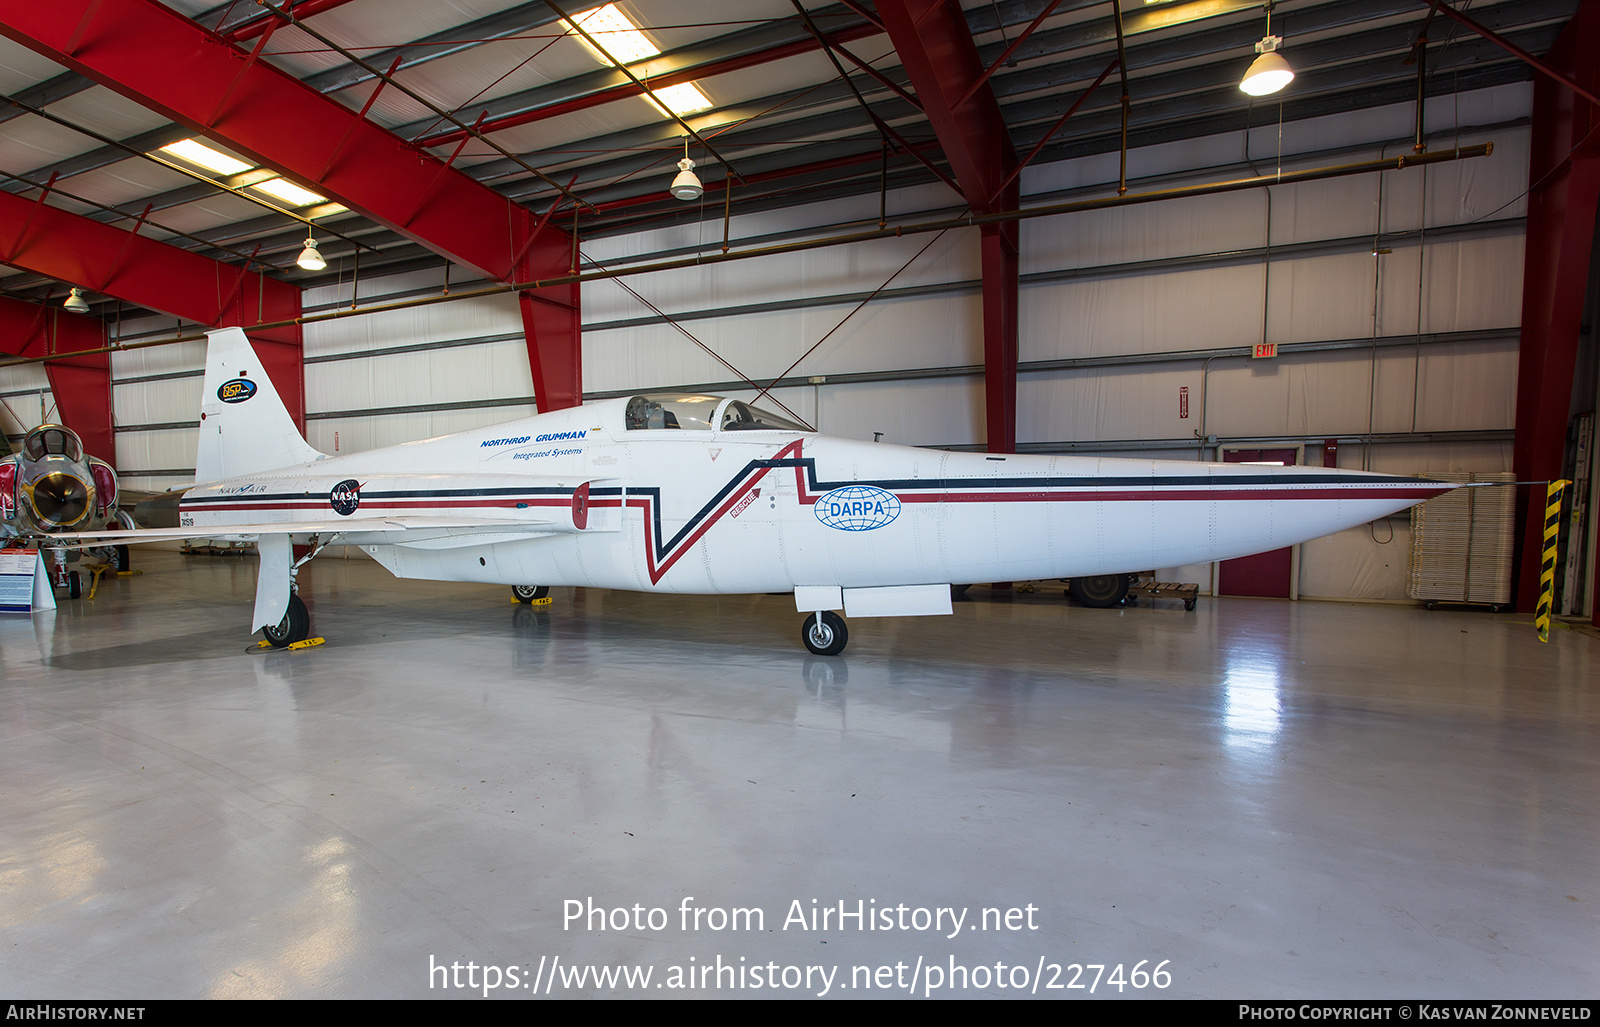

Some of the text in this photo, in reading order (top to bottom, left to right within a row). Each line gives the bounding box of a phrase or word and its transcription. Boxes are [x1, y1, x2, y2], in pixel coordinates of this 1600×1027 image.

[1256, 343, 1274, 357] EXIT
[480, 430, 587, 447] NORTHROP GRUMMAN
[512, 447, 584, 461] Integrated Systems
[332, 491, 358, 501] NASA
[730, 492, 756, 518] RESCUE
[831, 501, 884, 517] DARPA
